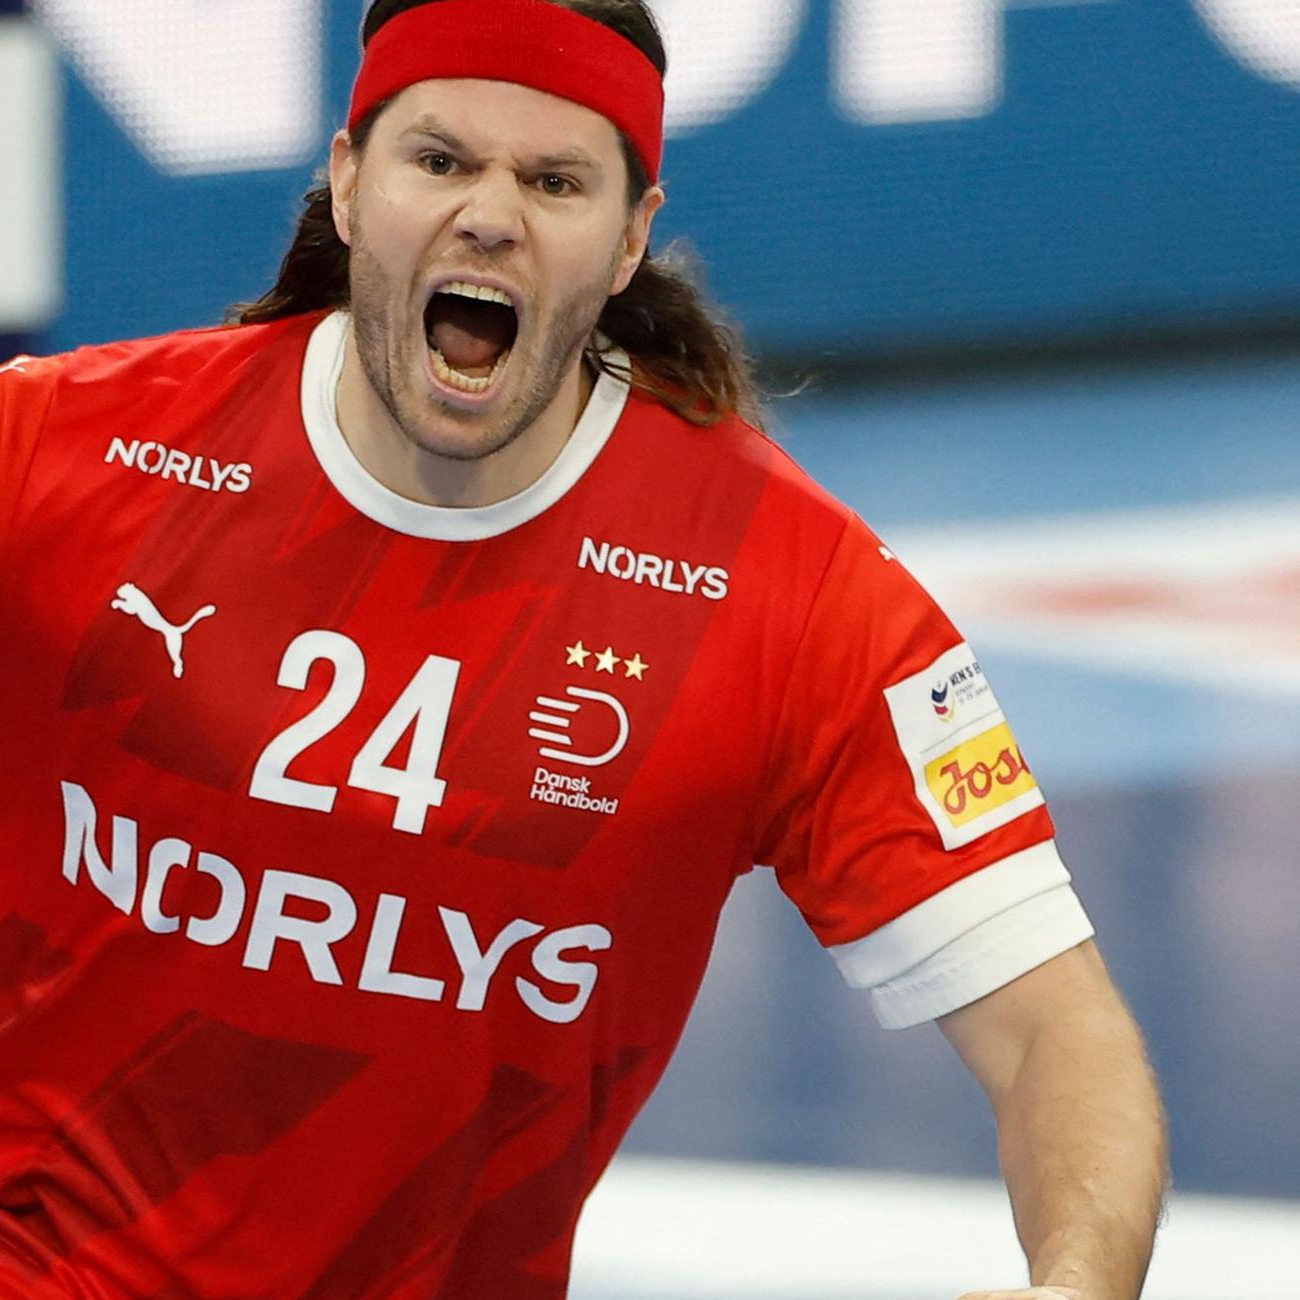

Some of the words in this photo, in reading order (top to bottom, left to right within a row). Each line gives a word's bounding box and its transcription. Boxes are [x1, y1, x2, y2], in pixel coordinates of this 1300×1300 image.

[106, 438, 252, 493] NORLYS
[578, 537, 729, 600] NORLYS
[249, 630, 461, 835] 24
[530, 783, 619, 815] Håndbold
[534, 767, 591, 794] Dansk
[61, 780, 613, 1023] NORLYS
